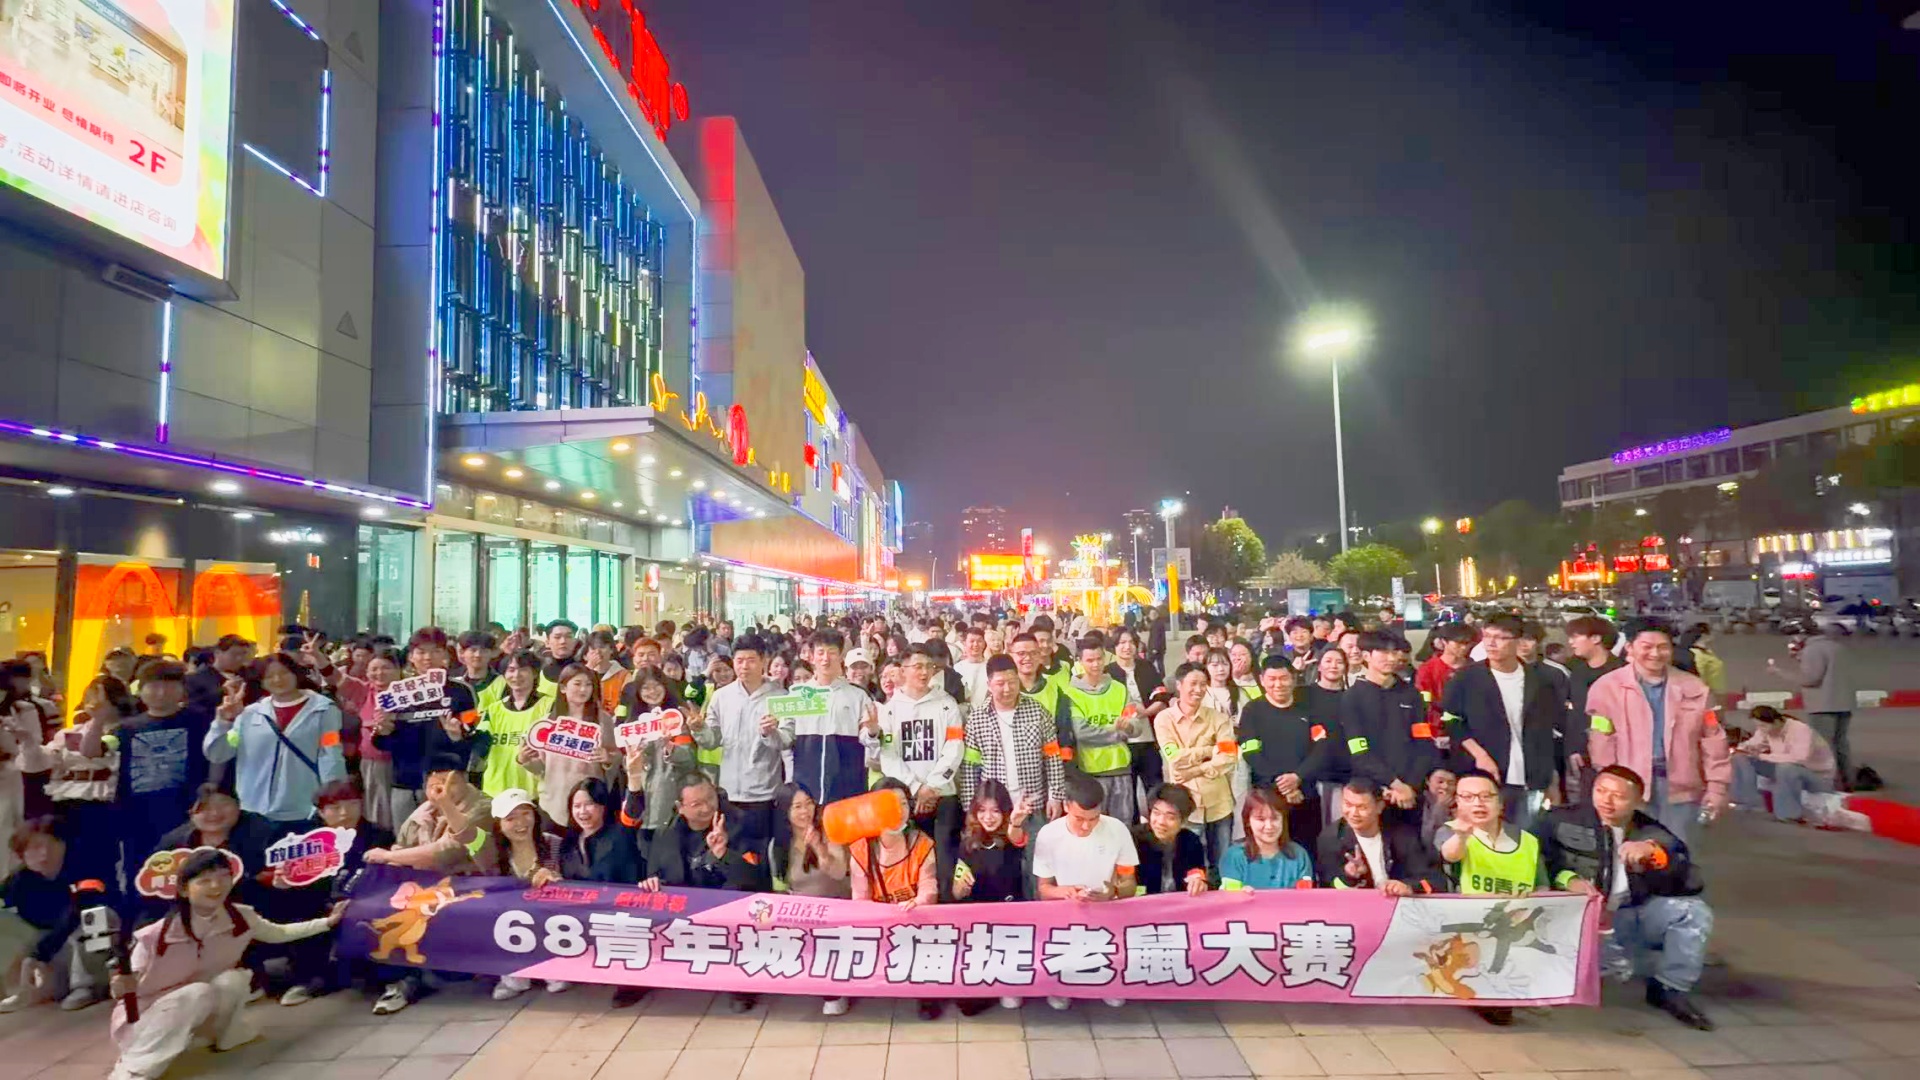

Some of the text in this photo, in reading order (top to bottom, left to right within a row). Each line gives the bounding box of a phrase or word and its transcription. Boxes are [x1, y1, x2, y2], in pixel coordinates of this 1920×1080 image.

[129, 139, 166, 173] 2F
[493, 909, 1356, 990] 68青年城市猫捉老鼠大赛
